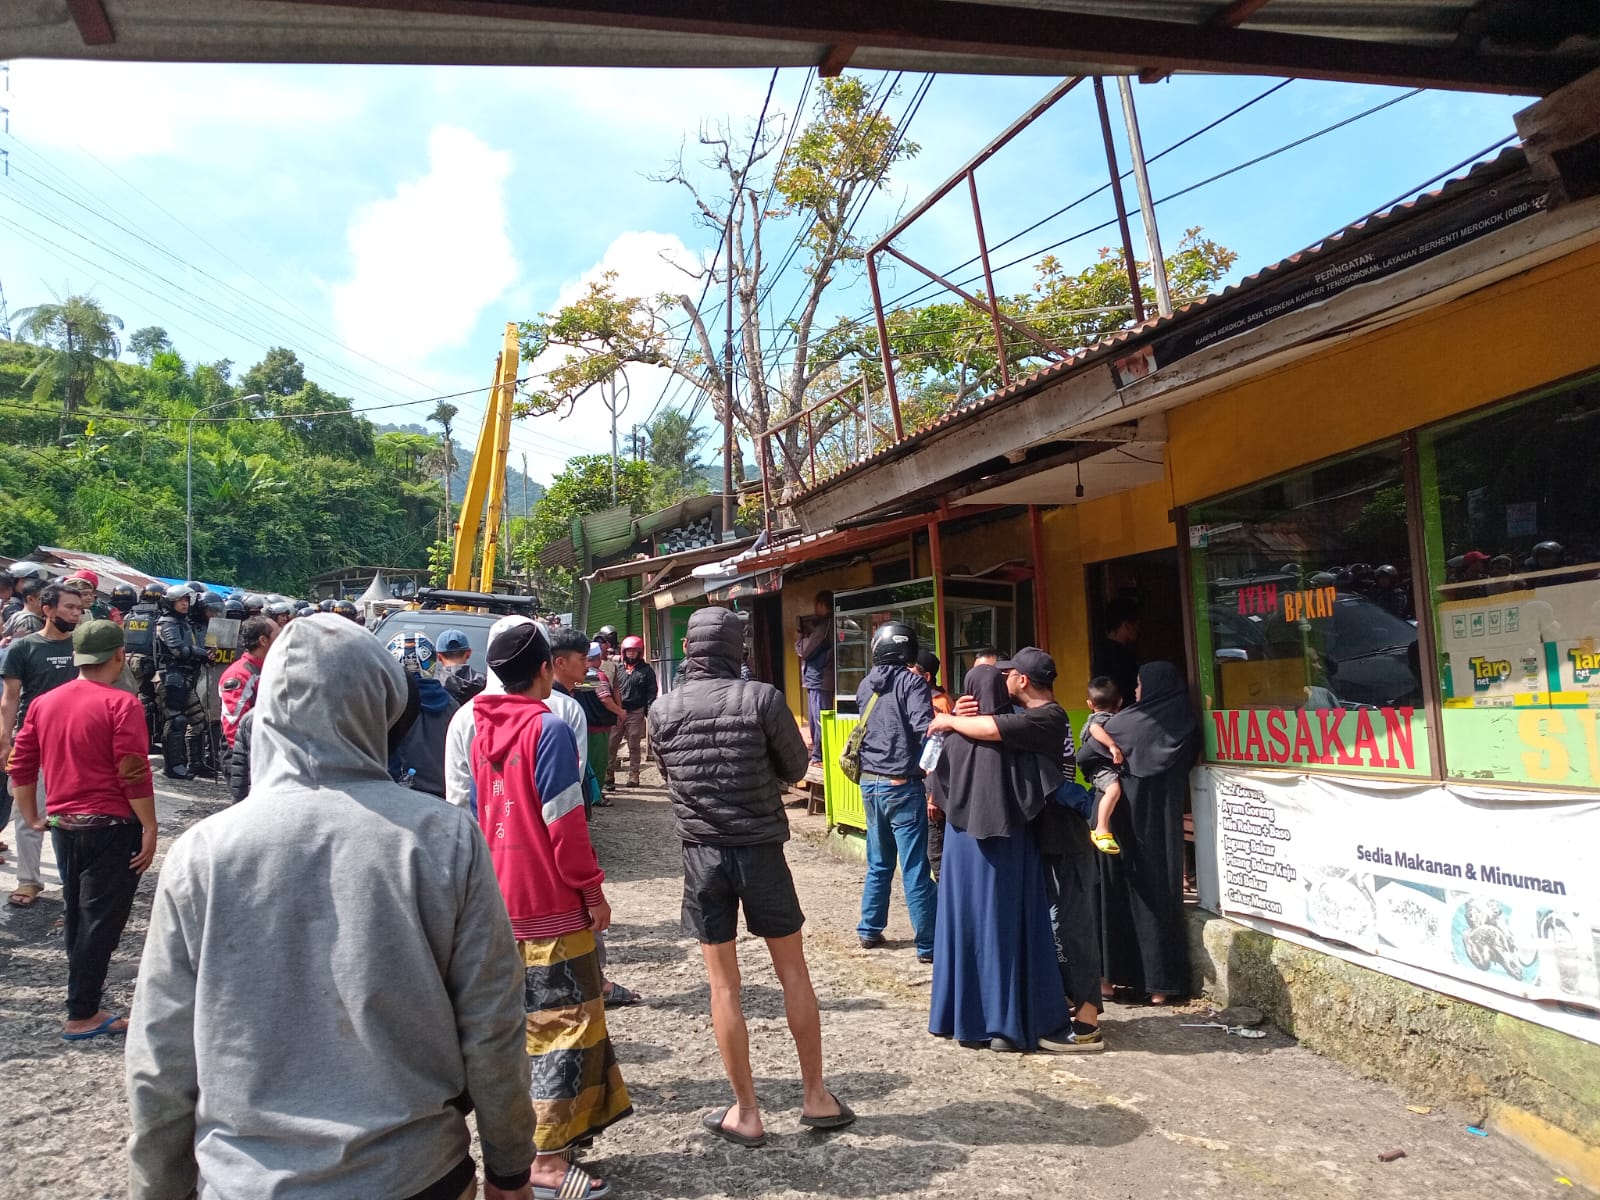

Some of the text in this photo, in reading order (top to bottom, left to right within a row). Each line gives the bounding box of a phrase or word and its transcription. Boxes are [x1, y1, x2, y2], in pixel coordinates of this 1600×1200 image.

[1247, 311, 1264, 324] SAYA
[1264, 298, 1295, 316] TERKENA
[1295, 284, 1325, 303] KANKER
[1382, 247, 1418, 268] LAYANAN
[1419, 231, 1460, 255] BERHENTI
[1460, 213, 1504, 238] MEROKOK
[1314, 253, 1376, 283] PERINGATAN:
[1238, 583, 1278, 615] AYAM
[1471, 656, 1511, 679] Taro
[1476, 678, 1489, 686] net
[1212, 705, 1416, 770] MASAKAN
[1222, 799, 1275, 823] Ayam Goreng
[1222, 816, 1292, 841] Mie Rebus + Baso
[1224, 834, 1275, 857] Jagung Bakar
[1225, 852, 1297, 883] Pisang Bakar Keju
[1357, 844, 1566, 896] Sedia Makanan & Minuman
[1226, 870, 1268, 892] Roti Bakar
[1250, 893, 1283, 915] Mercon
